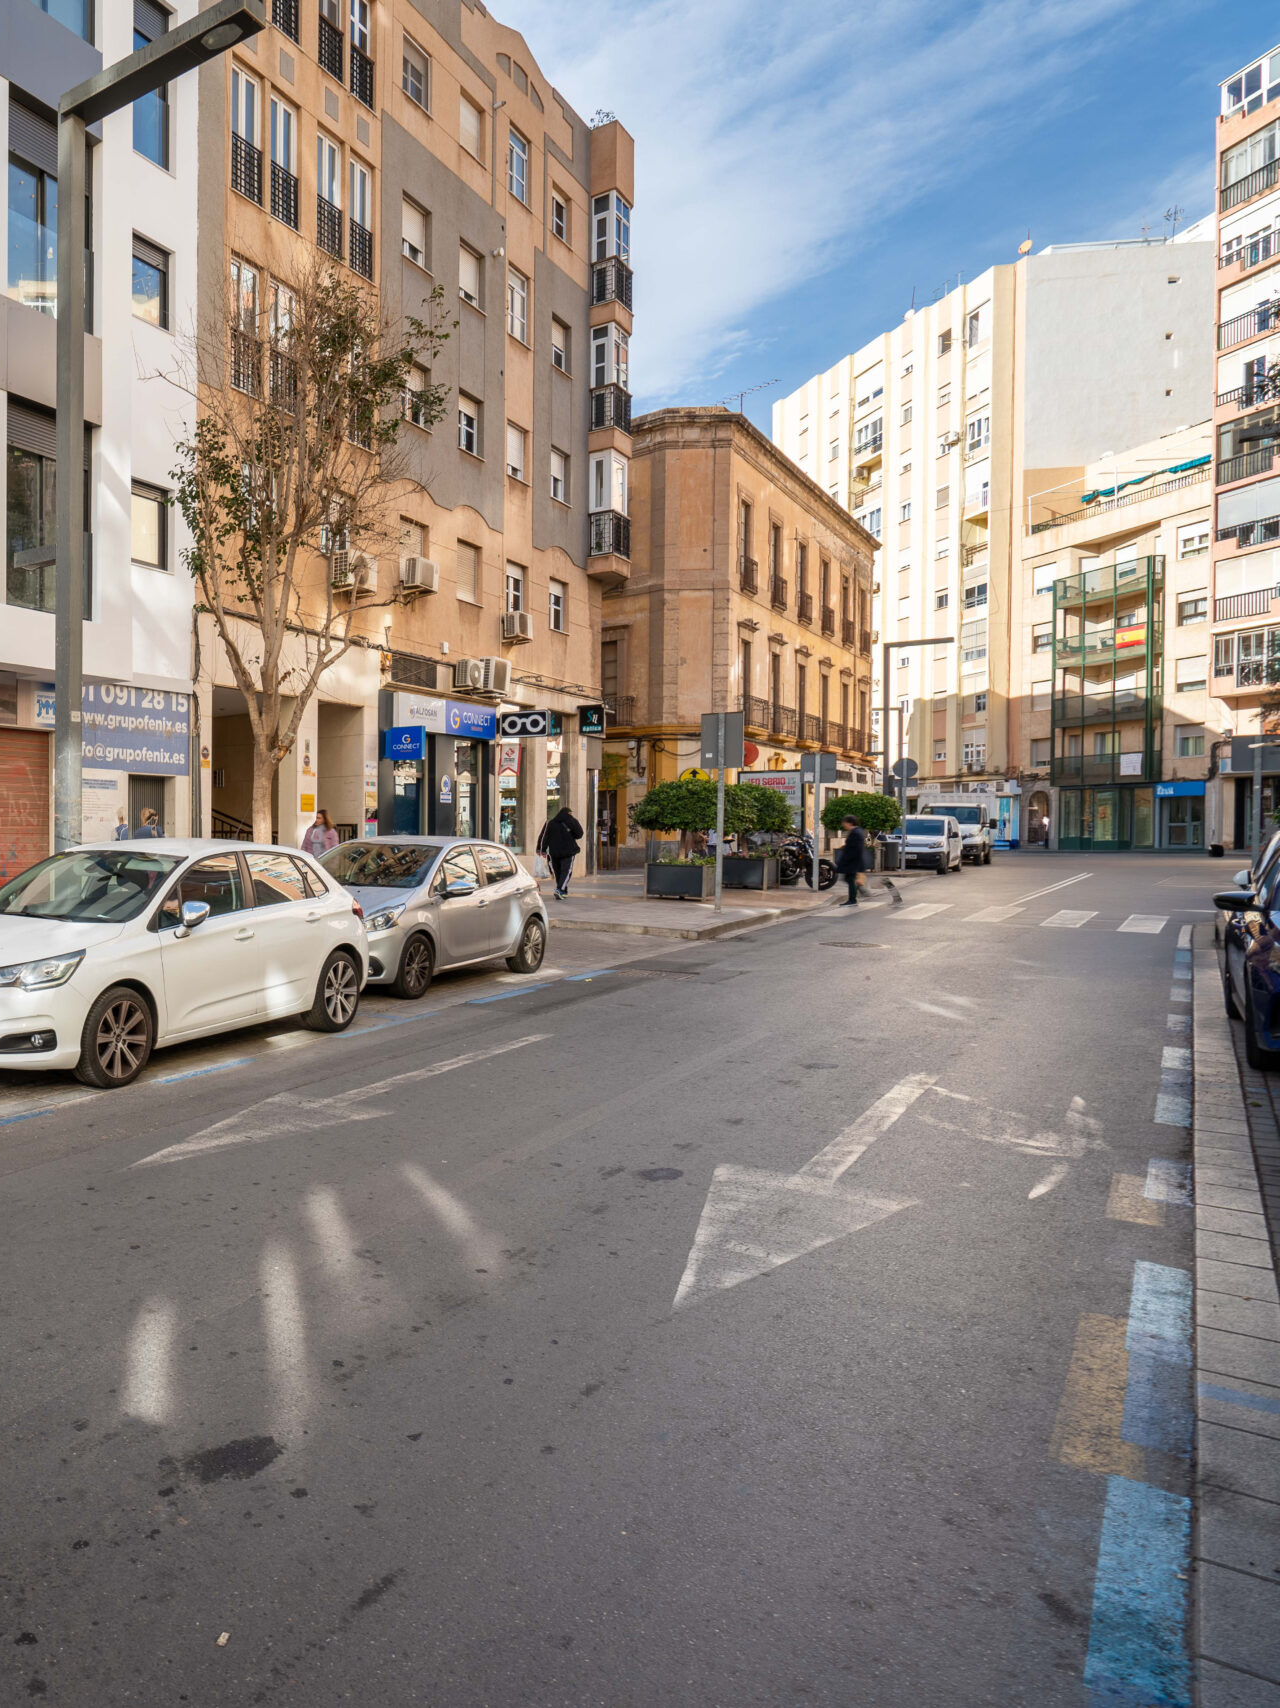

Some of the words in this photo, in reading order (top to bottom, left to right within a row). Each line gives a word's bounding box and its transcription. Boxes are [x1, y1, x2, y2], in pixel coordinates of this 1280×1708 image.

[101, 684, 135, 707] 091
[141, 689, 164, 710] 28
[170, 693, 188, 713] 15
[82, 711, 187, 734] ww.grupofenix.es
[462, 711, 491, 726] CONNECT
